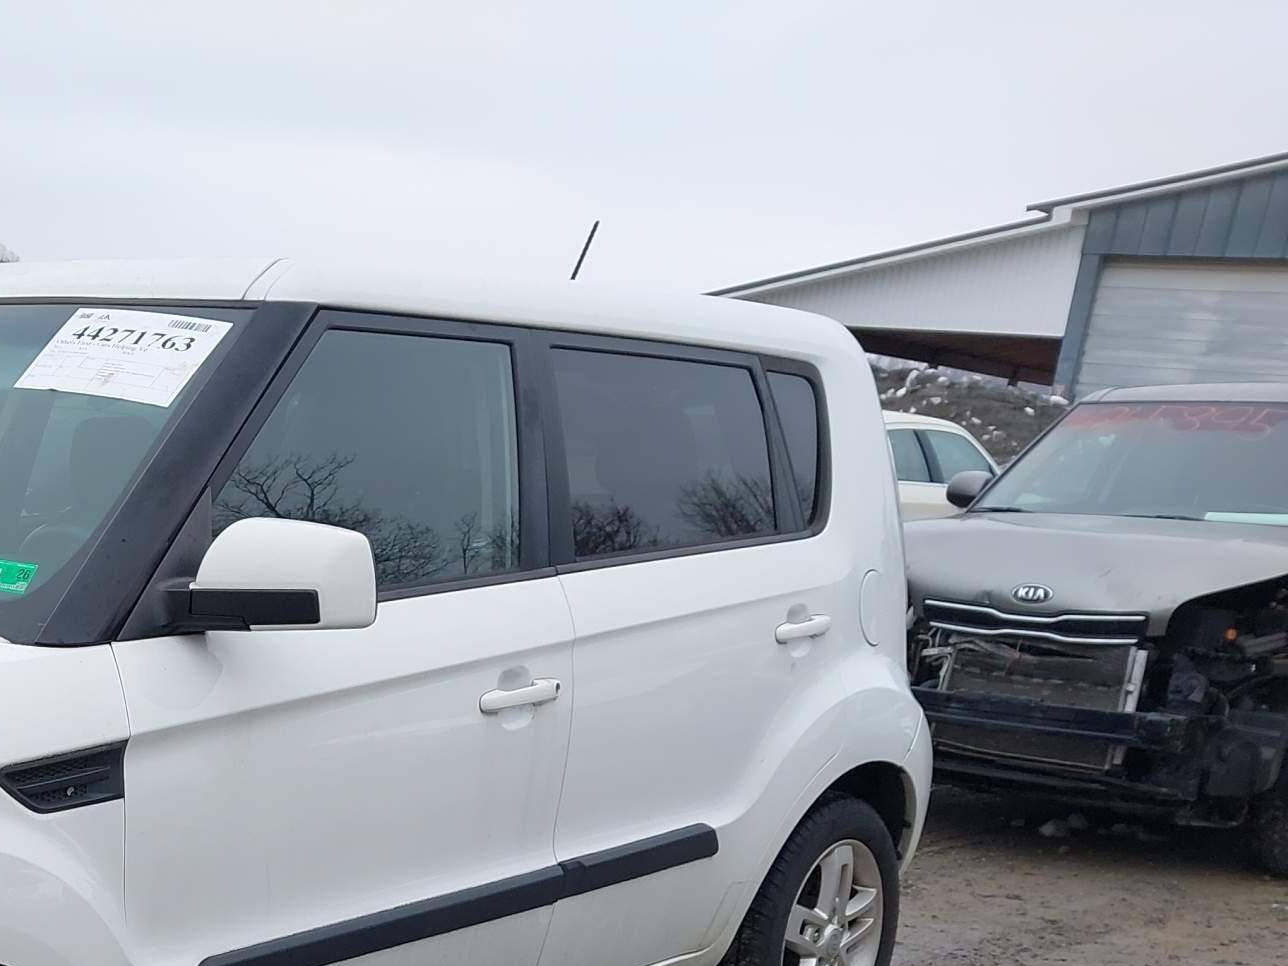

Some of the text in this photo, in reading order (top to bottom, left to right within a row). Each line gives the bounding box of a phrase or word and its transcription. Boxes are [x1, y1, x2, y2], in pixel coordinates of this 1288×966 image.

[72, 325, 196, 352] 44271763
[16, 568, 32, 580] 26
[1017, 586, 1045, 600] KIA
